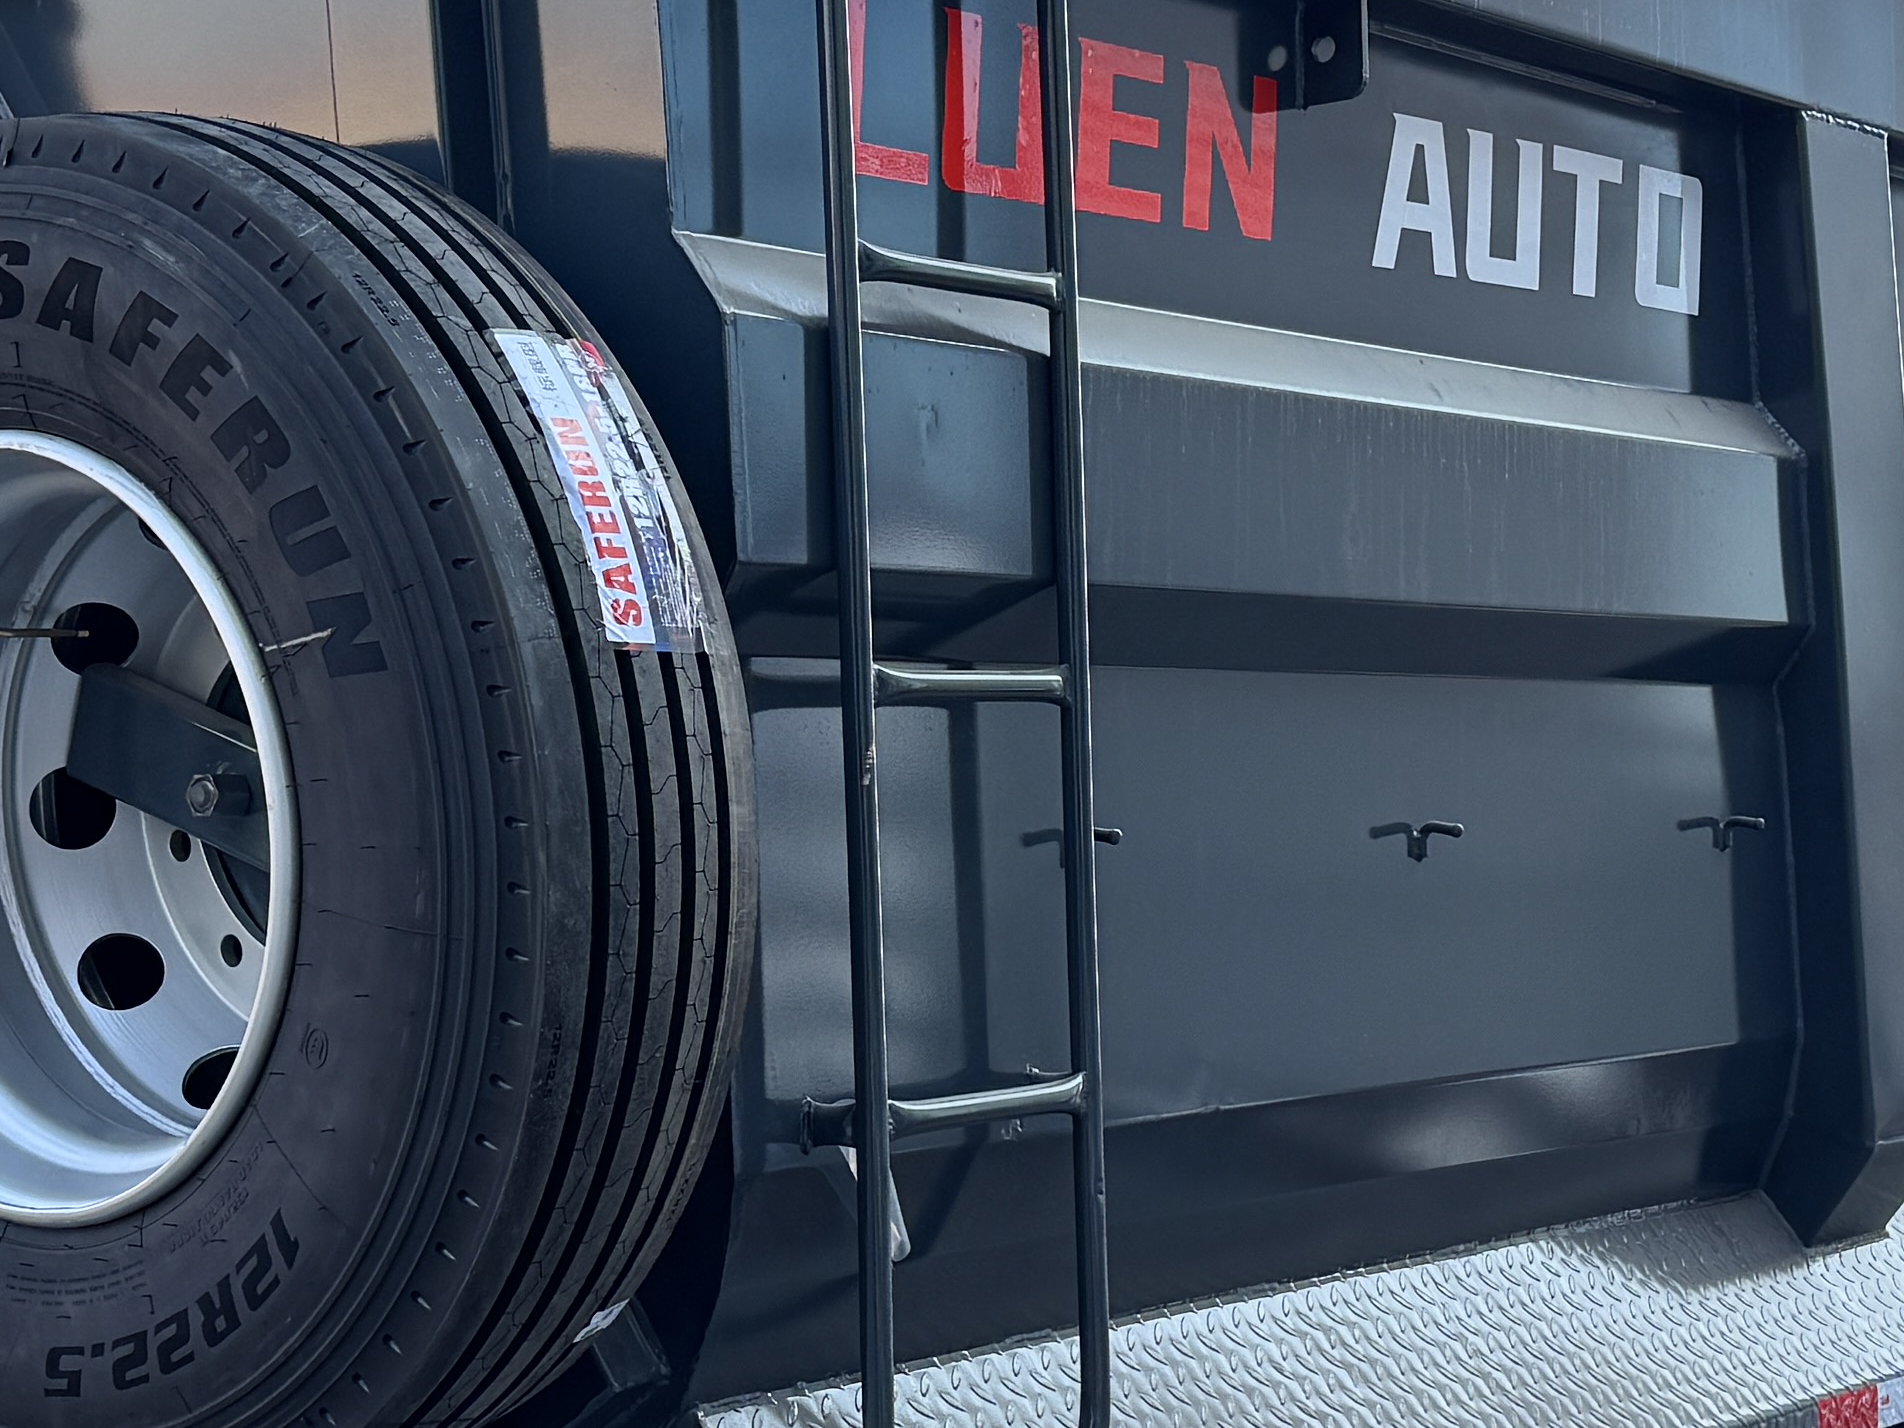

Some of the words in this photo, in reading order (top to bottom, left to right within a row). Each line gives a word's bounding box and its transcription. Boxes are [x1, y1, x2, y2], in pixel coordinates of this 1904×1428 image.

[1372, 112, 1703, 316] AUTO
[549, 416, 645, 629] SAFERUN
[43, 1206, 300, 1398] 12R22.5
